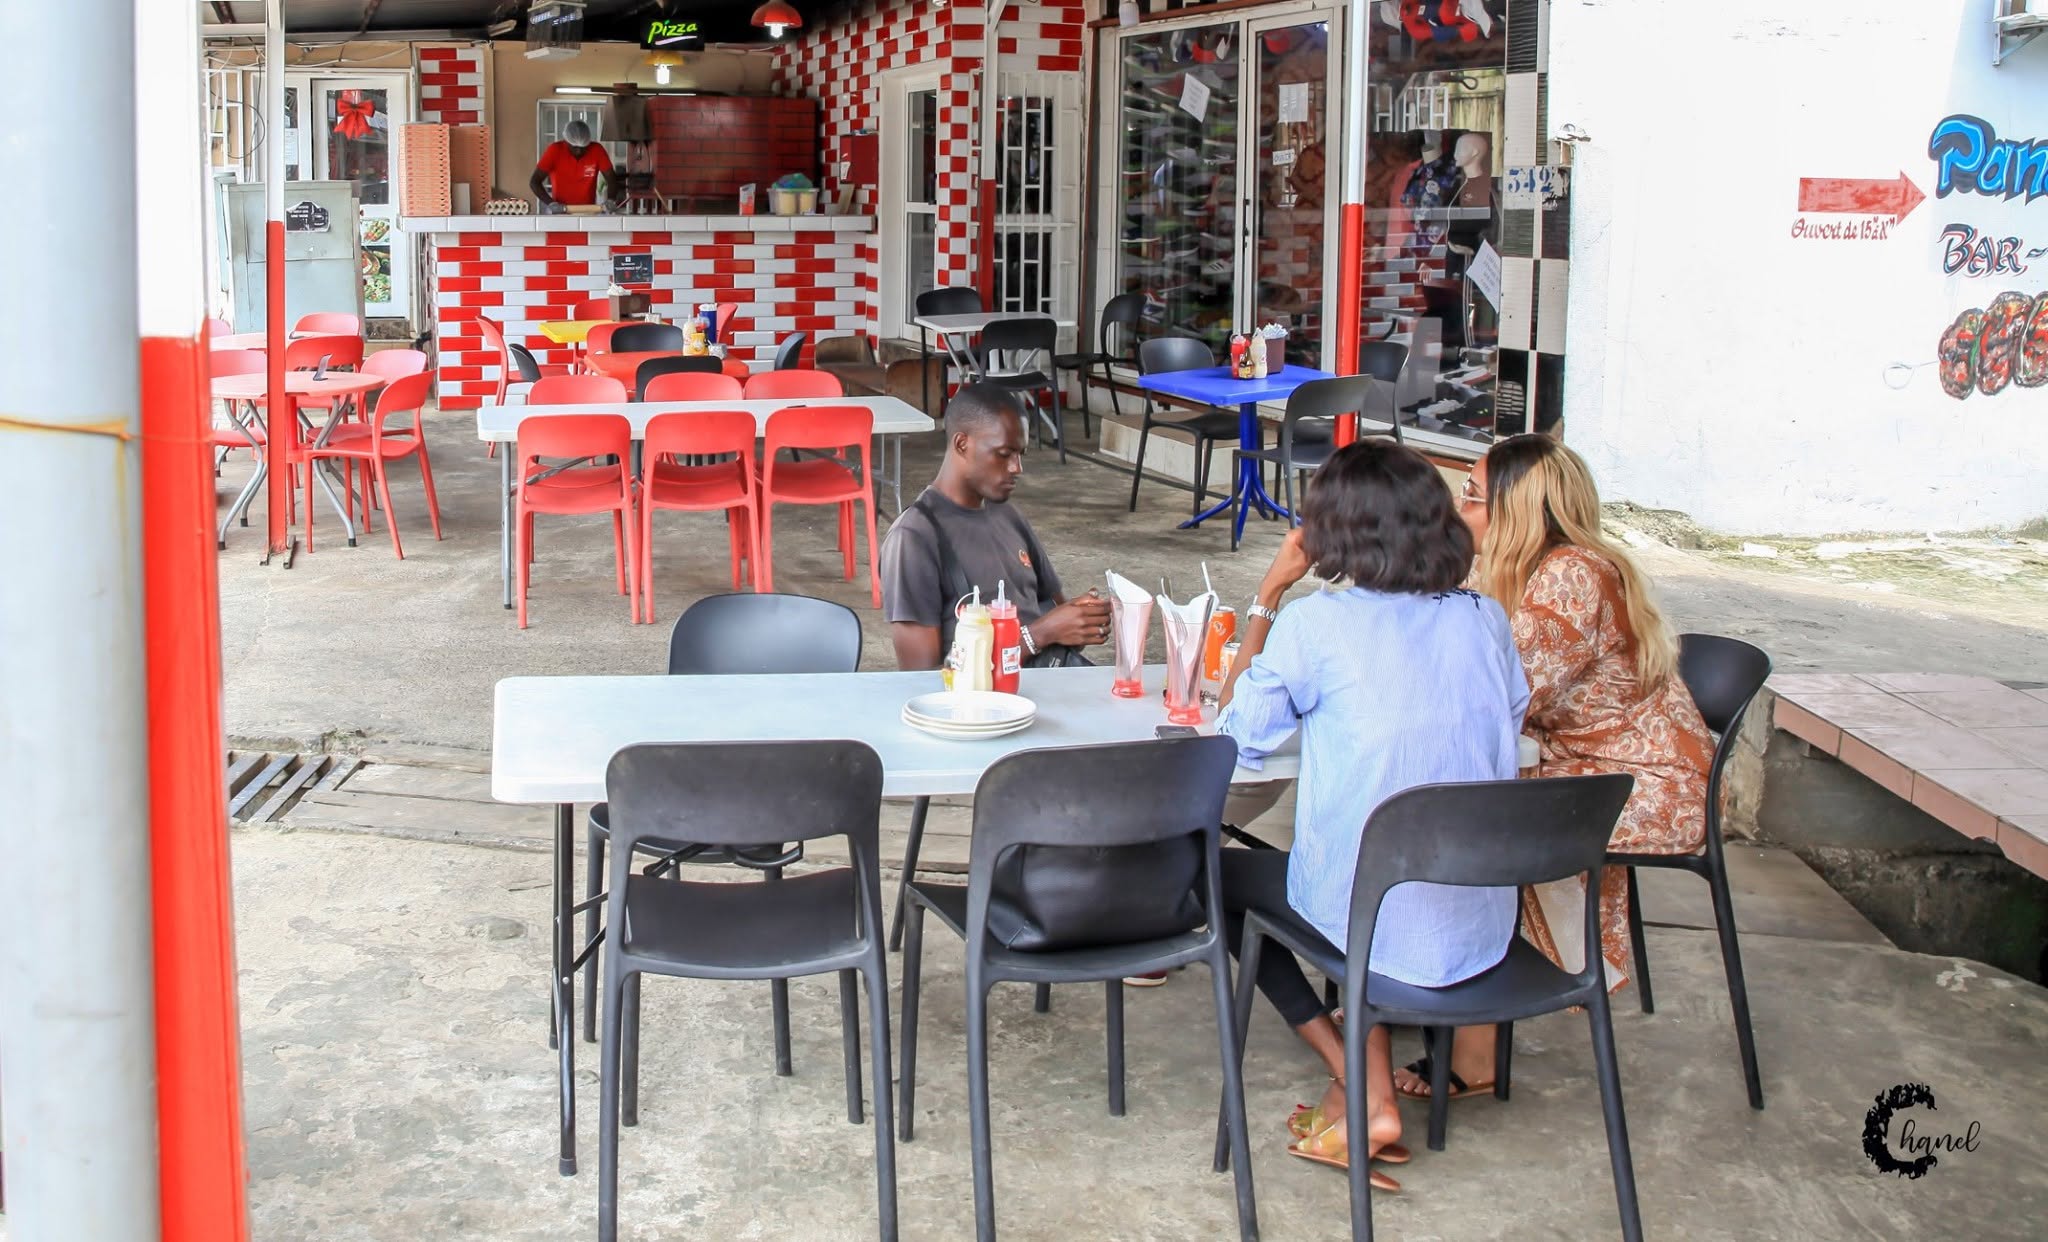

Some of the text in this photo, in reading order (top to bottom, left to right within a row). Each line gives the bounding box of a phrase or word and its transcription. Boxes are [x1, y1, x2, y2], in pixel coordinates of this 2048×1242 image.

[647, 19, 698, 44] Pizza
[1928, 113, 2048, 207] Pan
[1791, 217, 1841, 240] Ouvert
[1843, 220, 1857, 240] de
